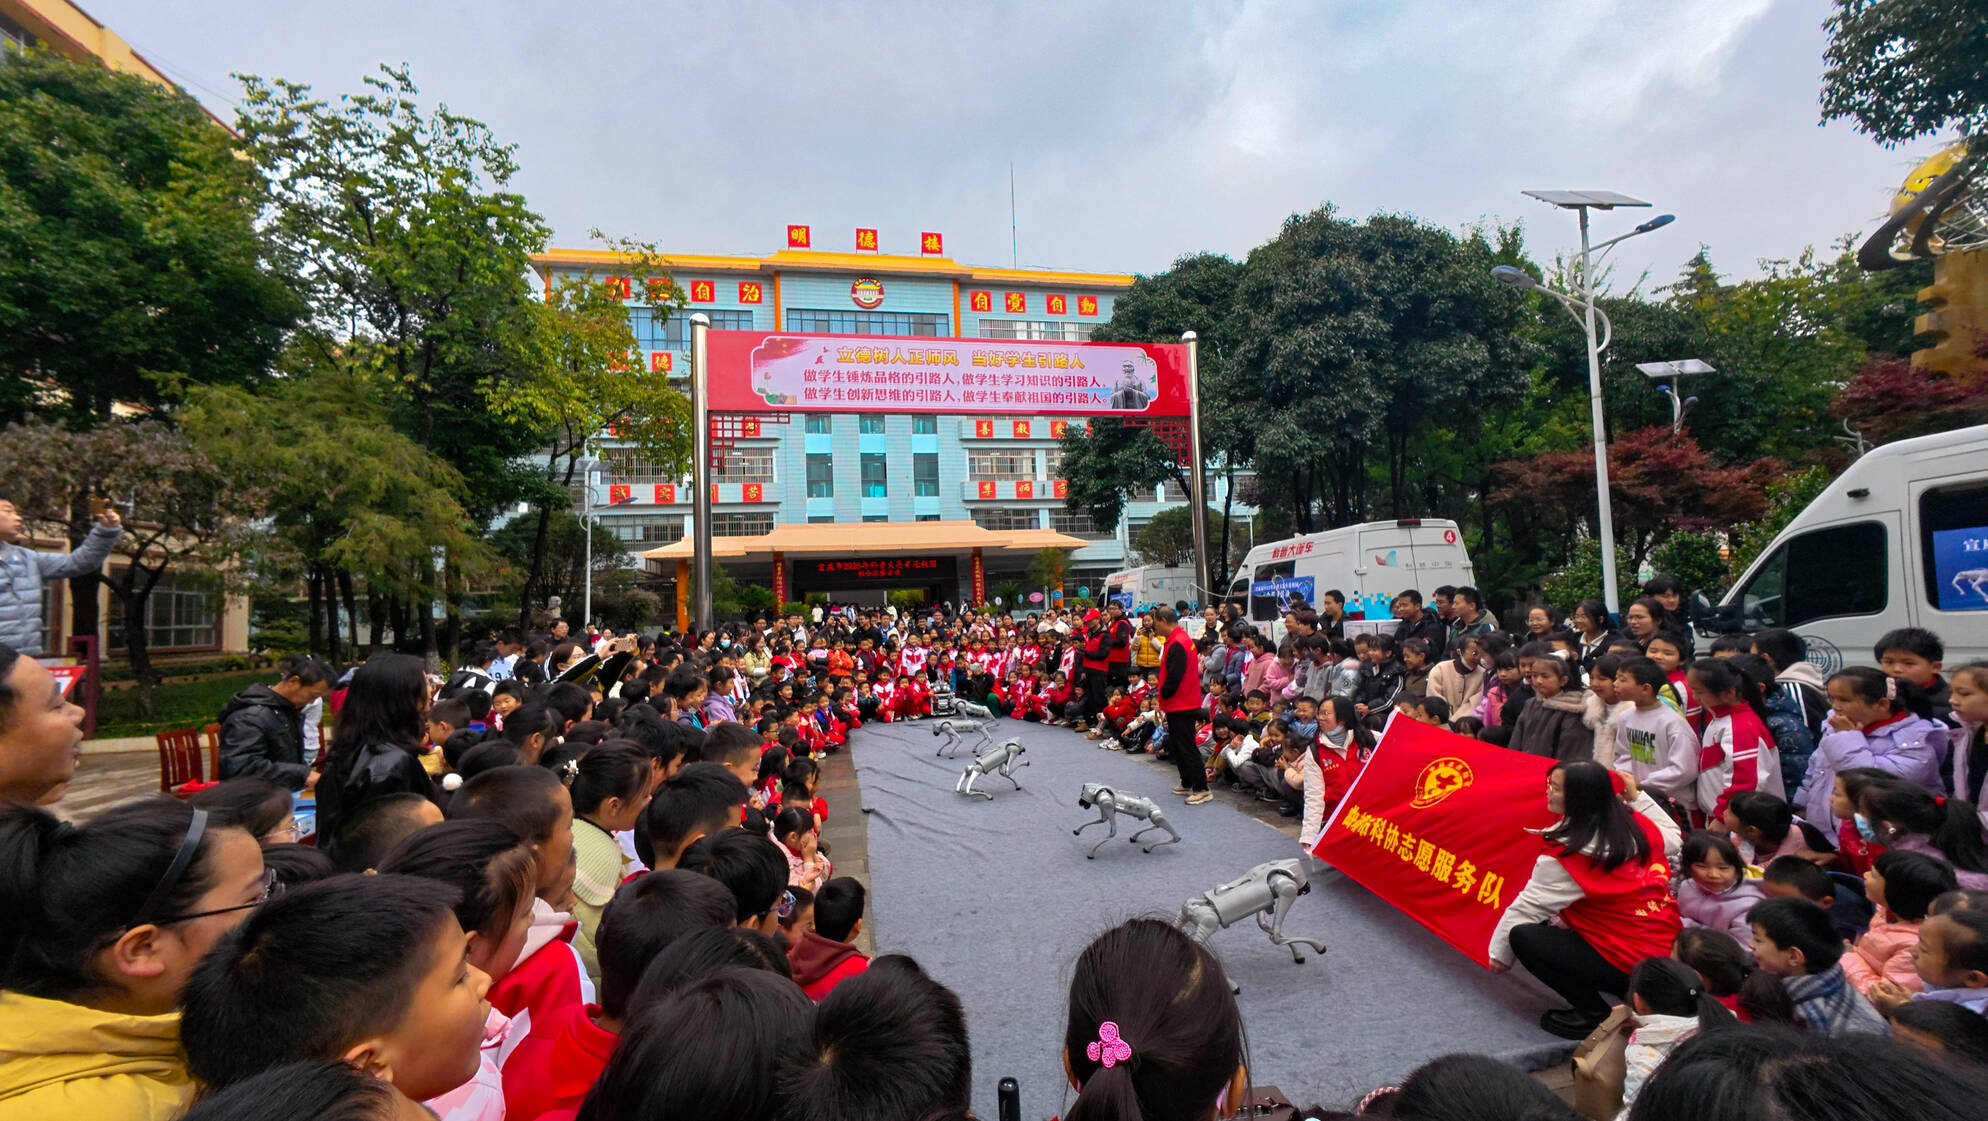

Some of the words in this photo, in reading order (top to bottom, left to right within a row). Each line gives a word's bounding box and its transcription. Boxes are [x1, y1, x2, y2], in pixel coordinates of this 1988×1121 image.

[836, 346, 959, 367] 立德树人正师风
[971, 349, 1086, 369] 当好学生引路人
[1446, 531, 1454, 543] 4
